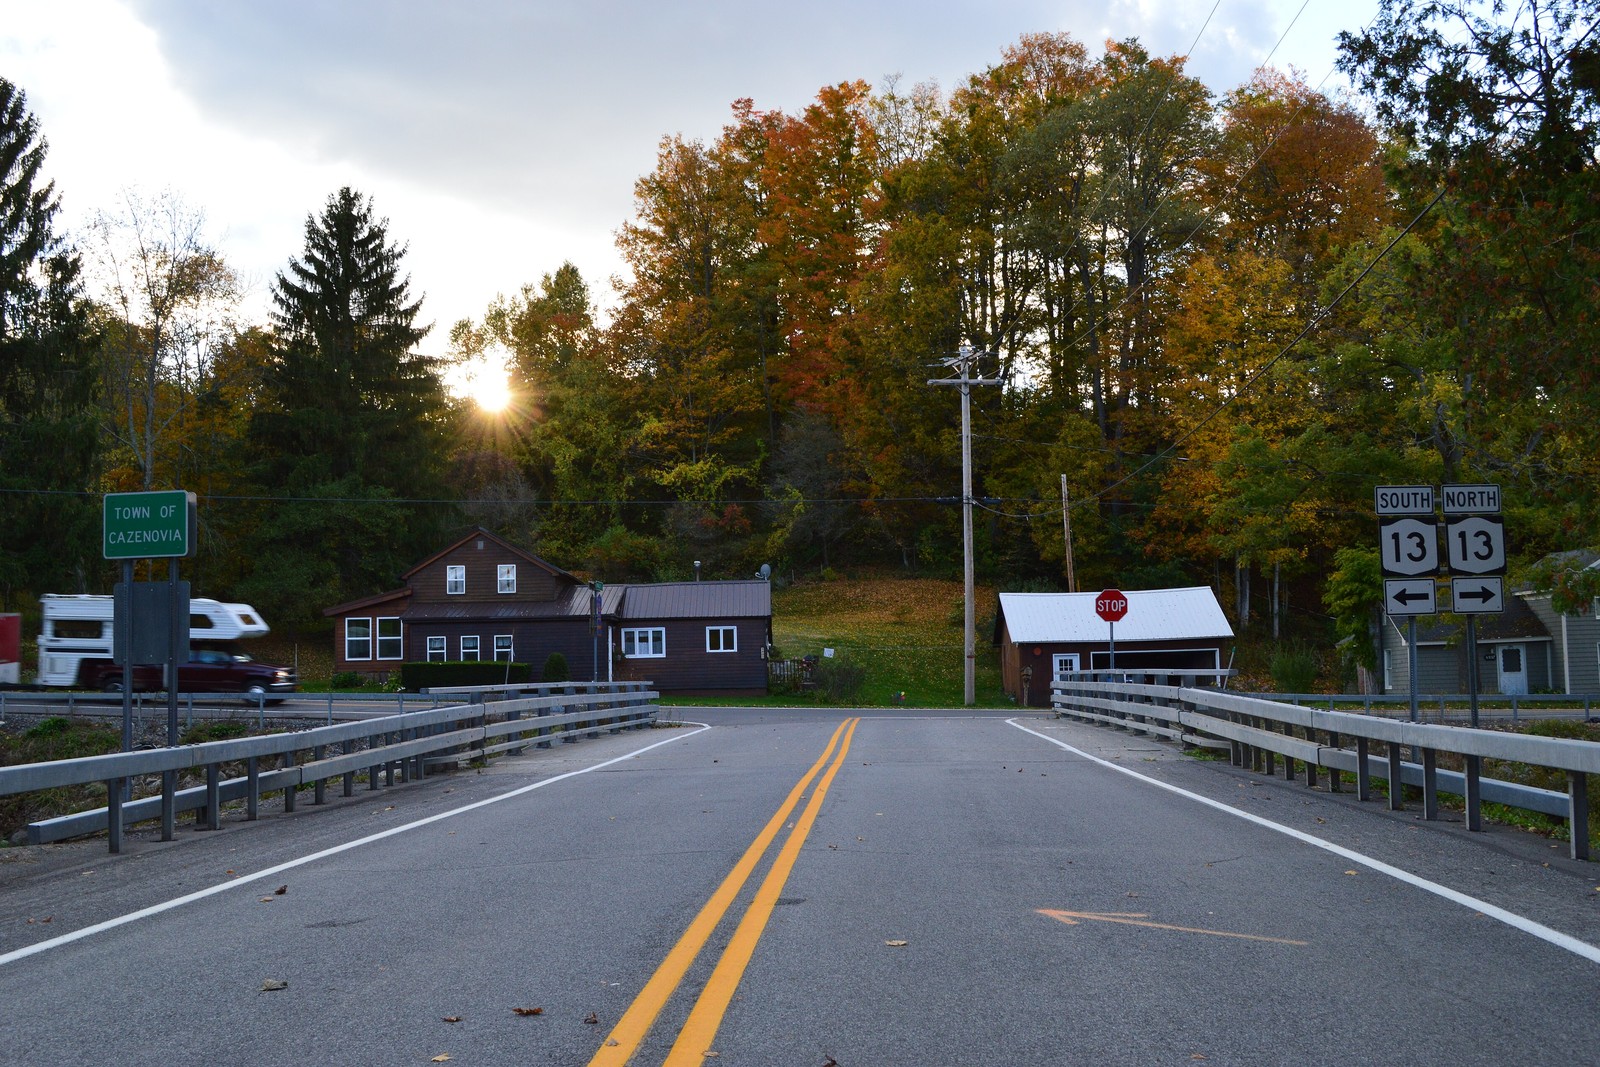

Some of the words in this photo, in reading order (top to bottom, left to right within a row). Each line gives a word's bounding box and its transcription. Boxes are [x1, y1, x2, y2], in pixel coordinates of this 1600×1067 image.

[1380, 492, 1430, 508] SOUTH
[1446, 491, 1497, 507] NORTH
[114, 506, 150, 519] TOWN
[160, 505, 176, 518] OF
[109, 529, 182, 544] CAZENOVIA
[1391, 531, 1427, 563] 13
[1458, 530, 1494, 561] 13
[1097, 599, 1126, 612] STOP
